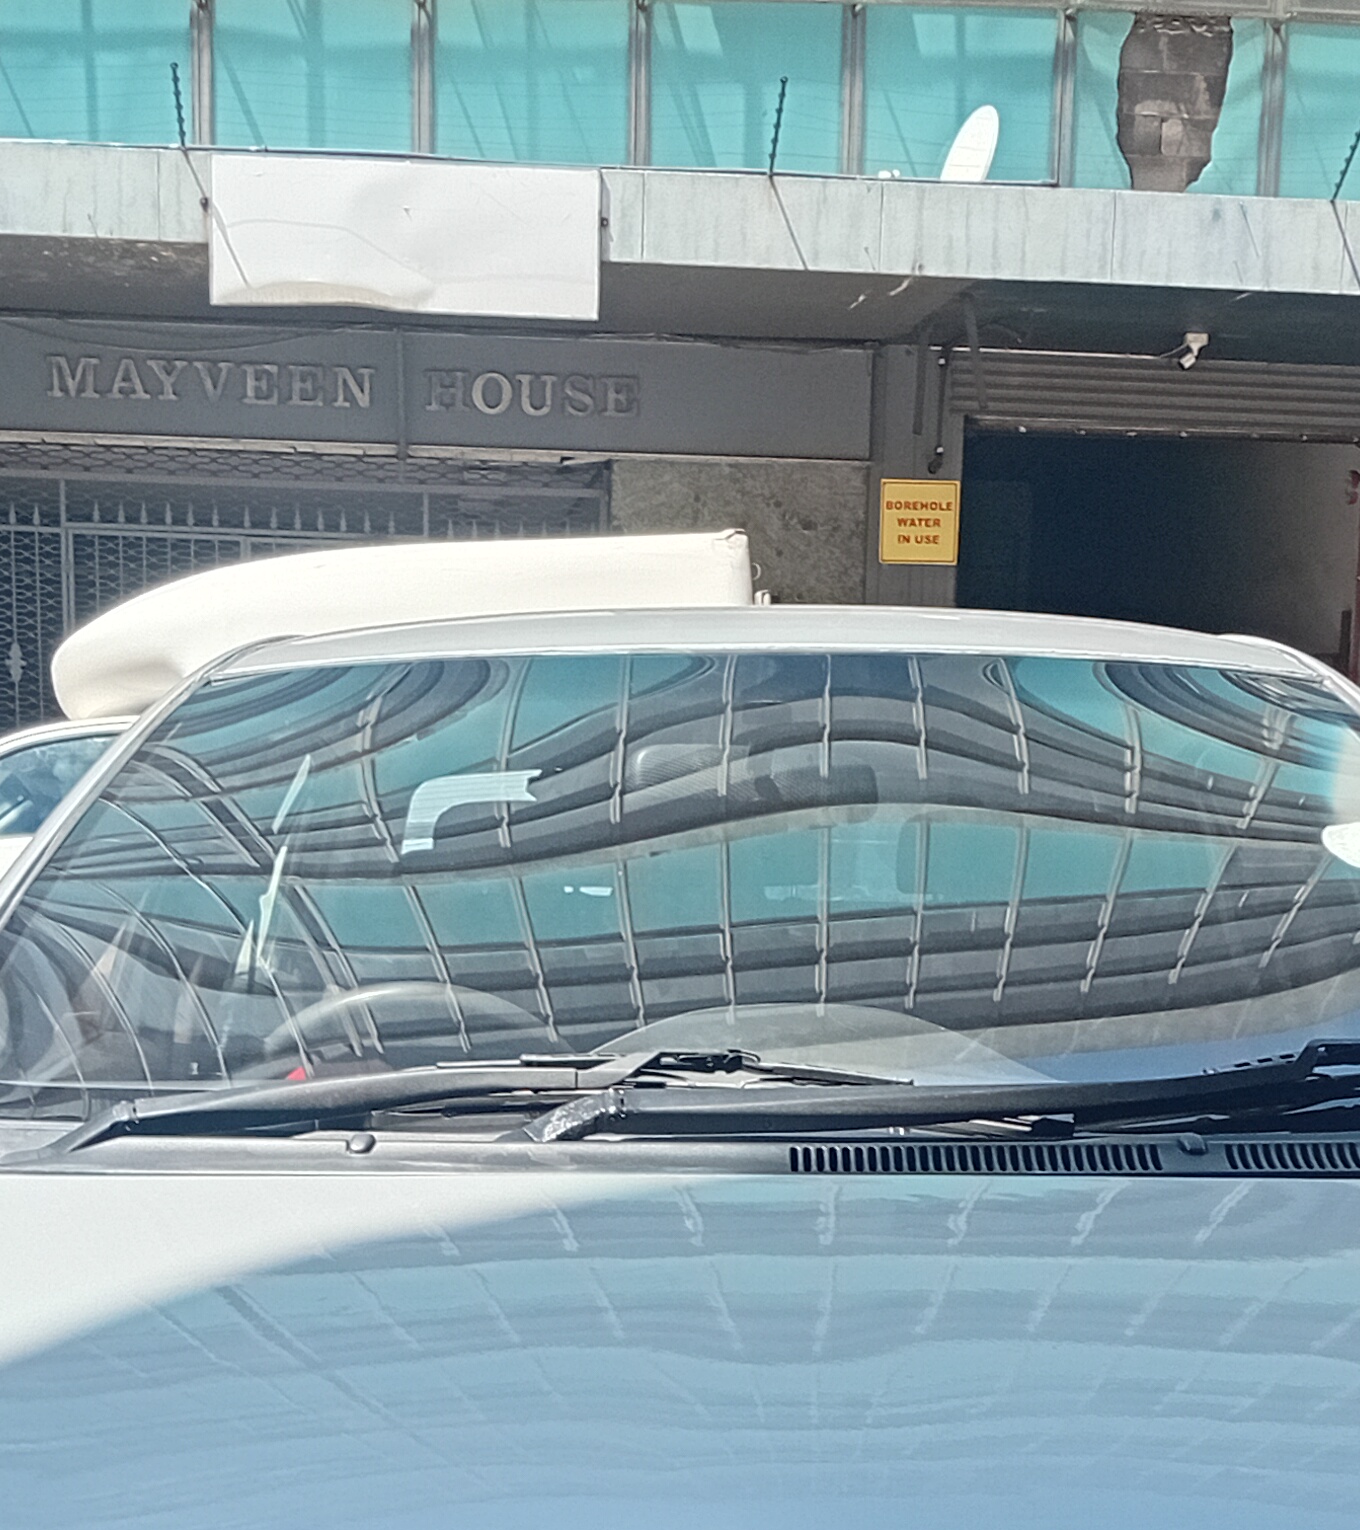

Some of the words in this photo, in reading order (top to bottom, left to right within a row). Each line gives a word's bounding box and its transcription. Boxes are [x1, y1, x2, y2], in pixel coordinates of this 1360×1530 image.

[46, 355, 376, 409] MAYVEEN
[424, 368, 640, 417] HOUSE
[885, 500, 953, 511] BOREHOLE
[897, 518, 941, 528] WATER
[897, 534, 910, 544] IN
[915, 535, 940, 545] USE
